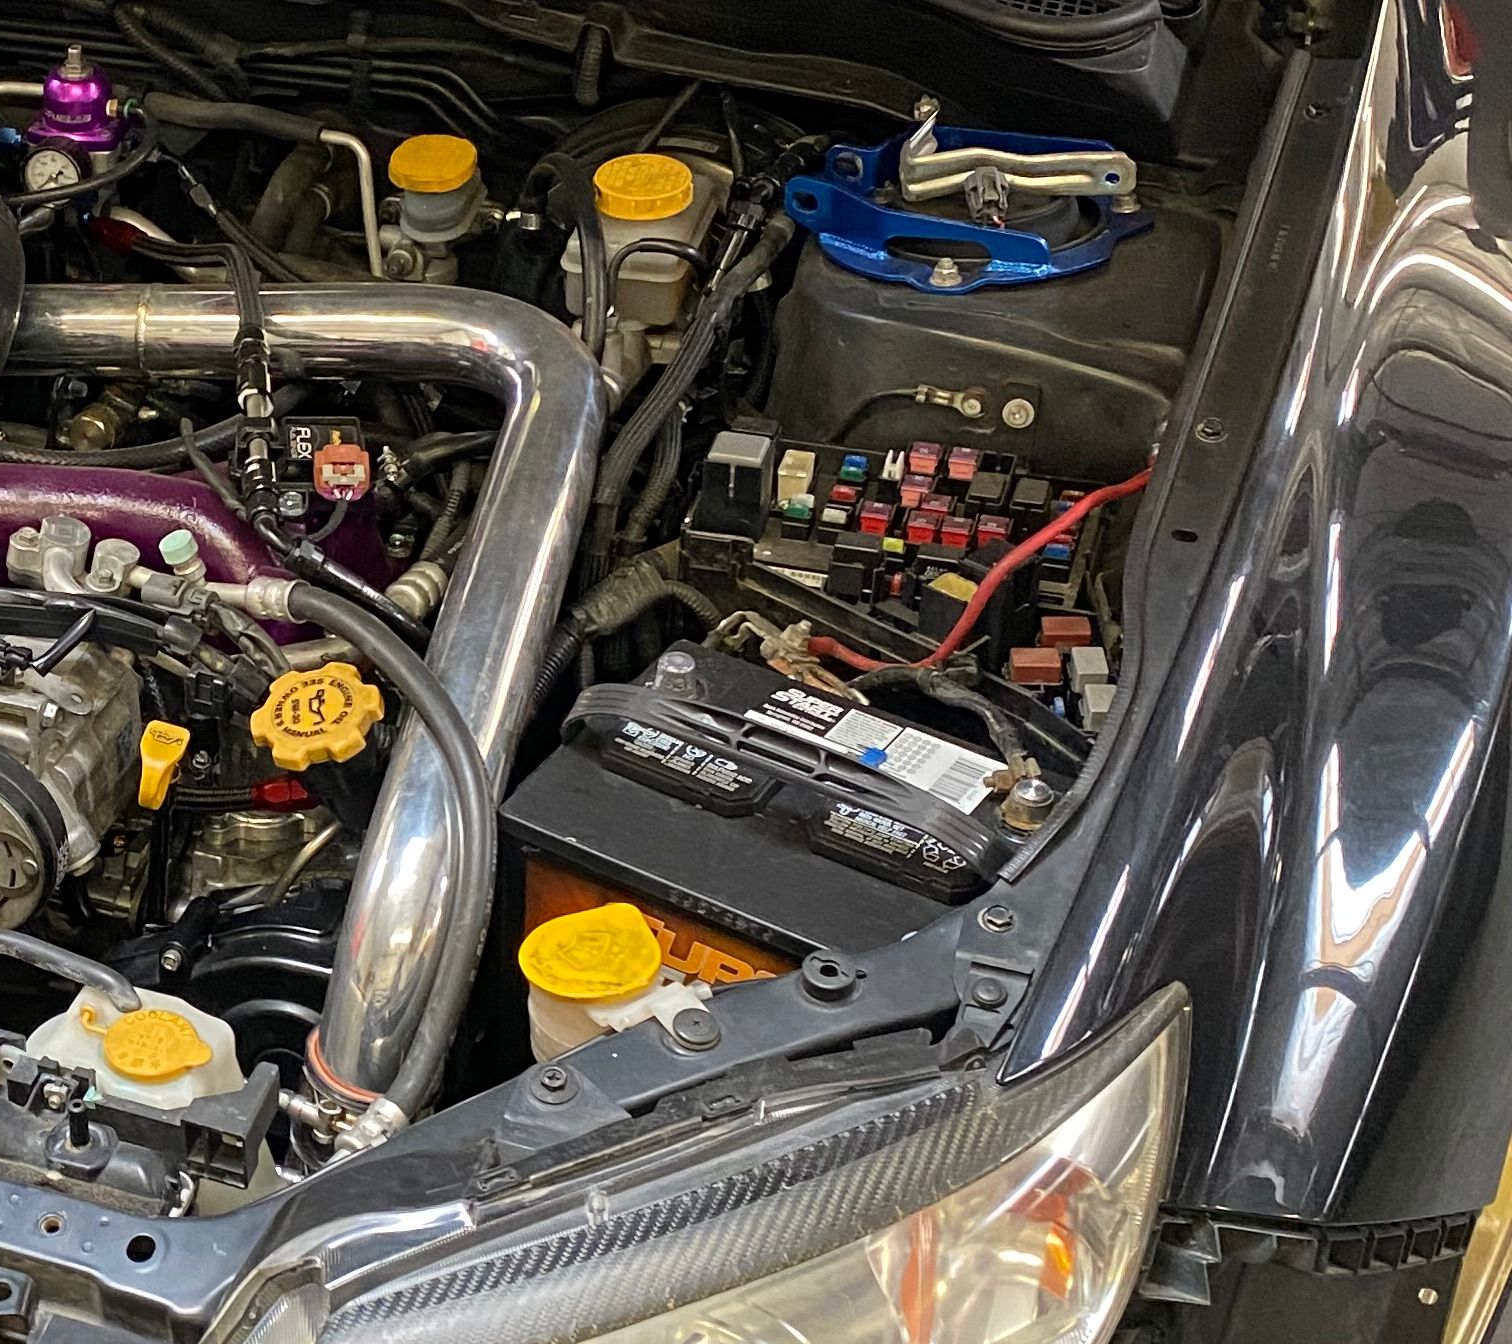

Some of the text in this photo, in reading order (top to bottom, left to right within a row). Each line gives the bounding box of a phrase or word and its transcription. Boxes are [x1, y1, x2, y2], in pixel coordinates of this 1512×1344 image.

[296, 426, 313, 459] FLEX
[328, 679, 353, 725] ENGINE OIL
[281, 725, 328, 738] MANUAL
